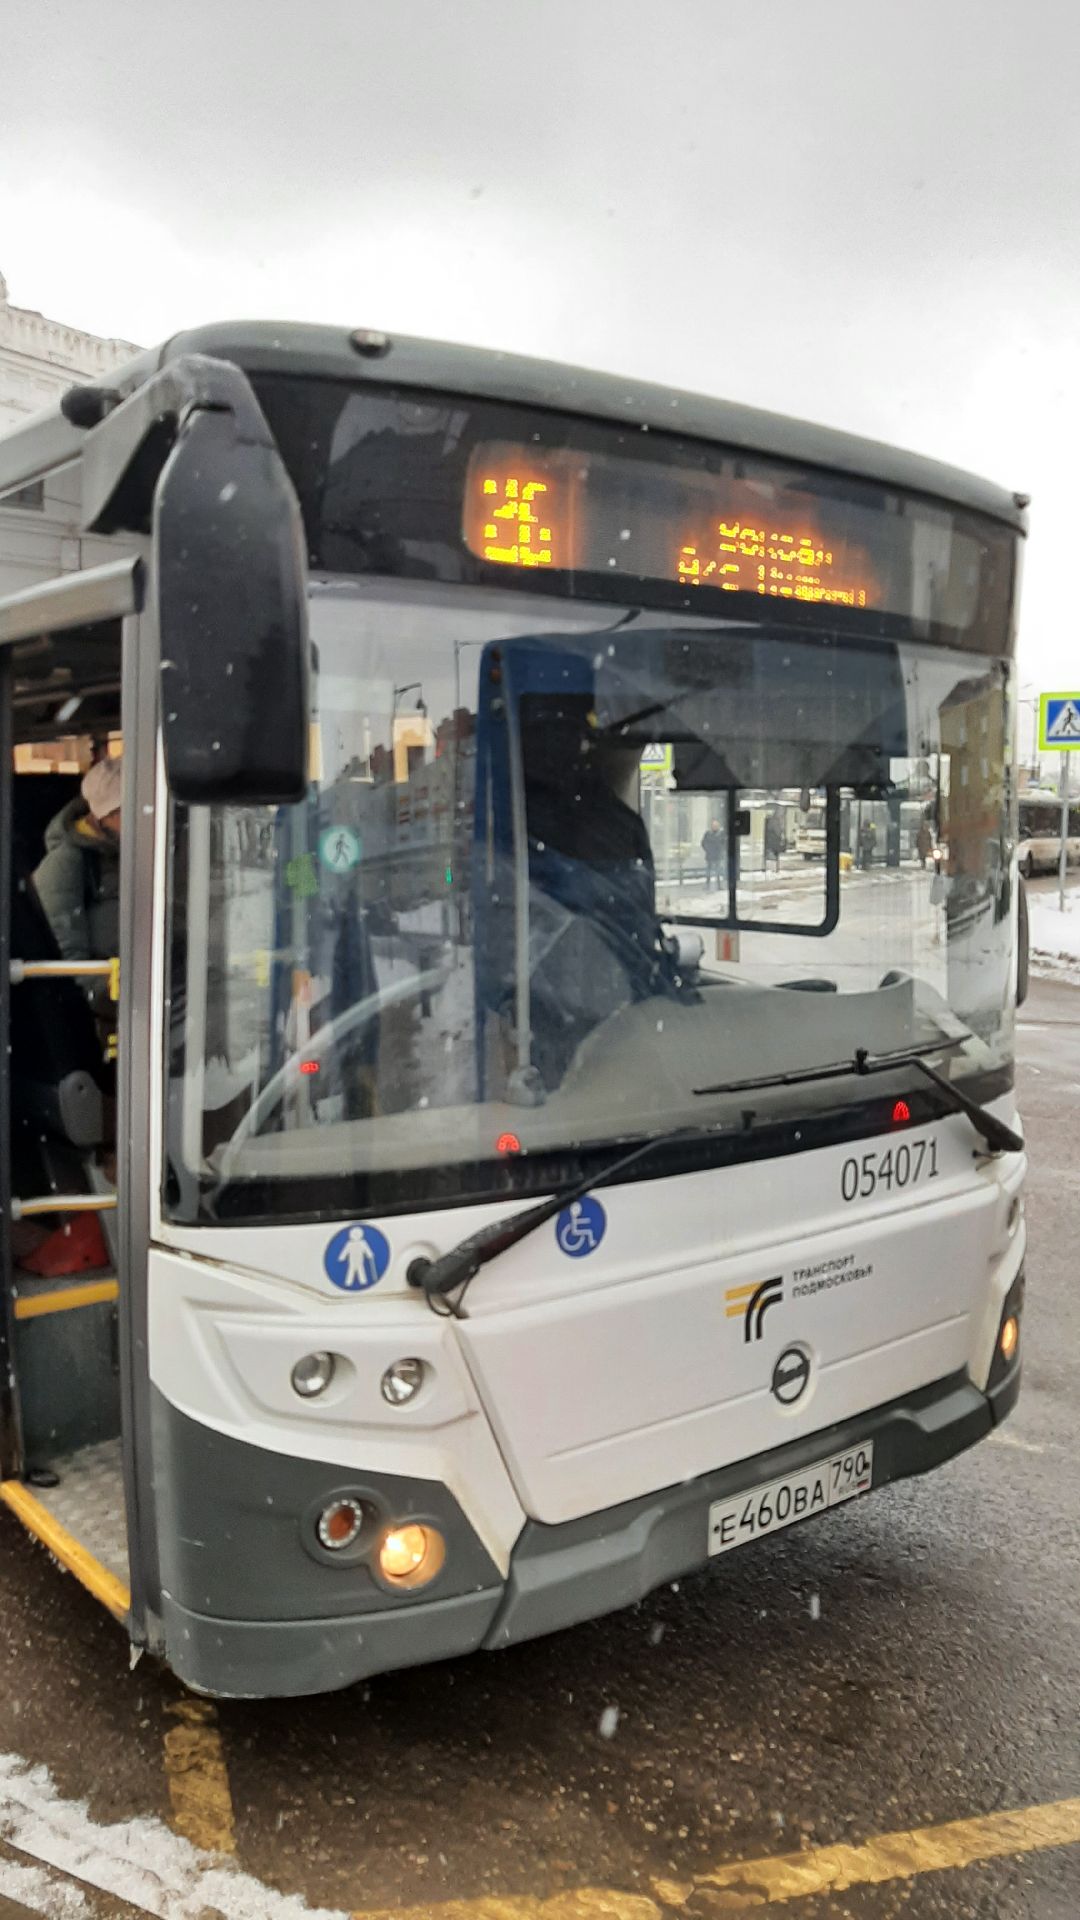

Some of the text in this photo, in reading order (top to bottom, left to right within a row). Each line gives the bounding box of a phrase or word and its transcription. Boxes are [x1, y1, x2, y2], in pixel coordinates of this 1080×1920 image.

[841, 1136, 940, 1201] 054071
[791, 1263, 874, 1299] ПОДМОСКОВЬЯ
[792, 1253, 856, 1282] ТРАНСПОРТ
[720, 1451, 867, 1546] Е460ВА 790
